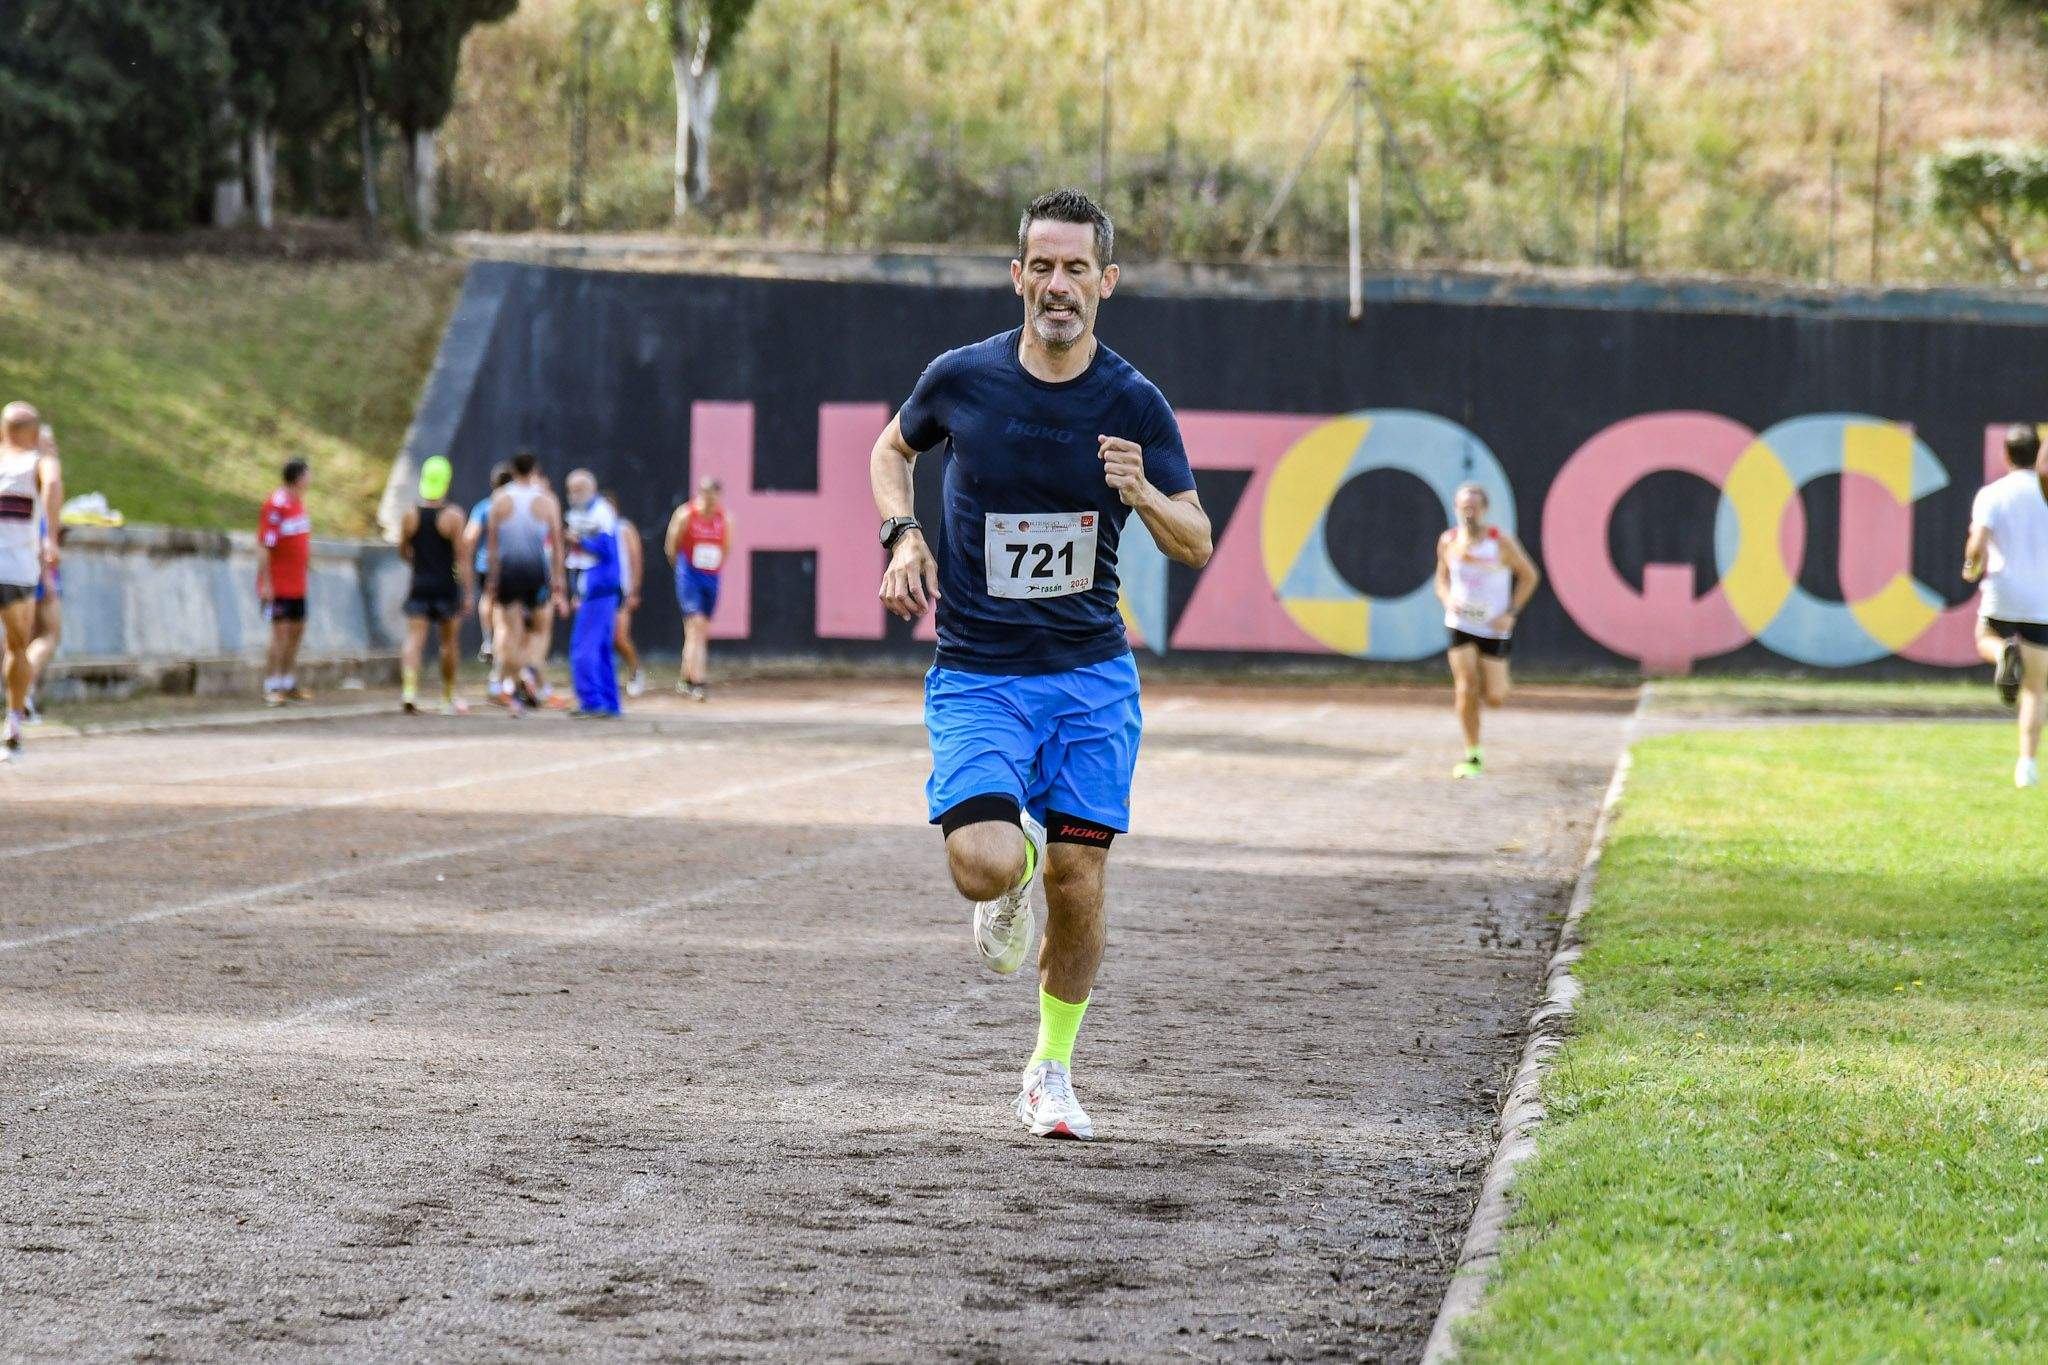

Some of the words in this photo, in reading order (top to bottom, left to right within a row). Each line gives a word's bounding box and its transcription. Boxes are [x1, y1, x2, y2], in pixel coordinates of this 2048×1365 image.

[1005, 541, 1074, 579] 721
[1070, 577, 1089, 589] 2023
[1060, 825, 1109, 840] HOKO
